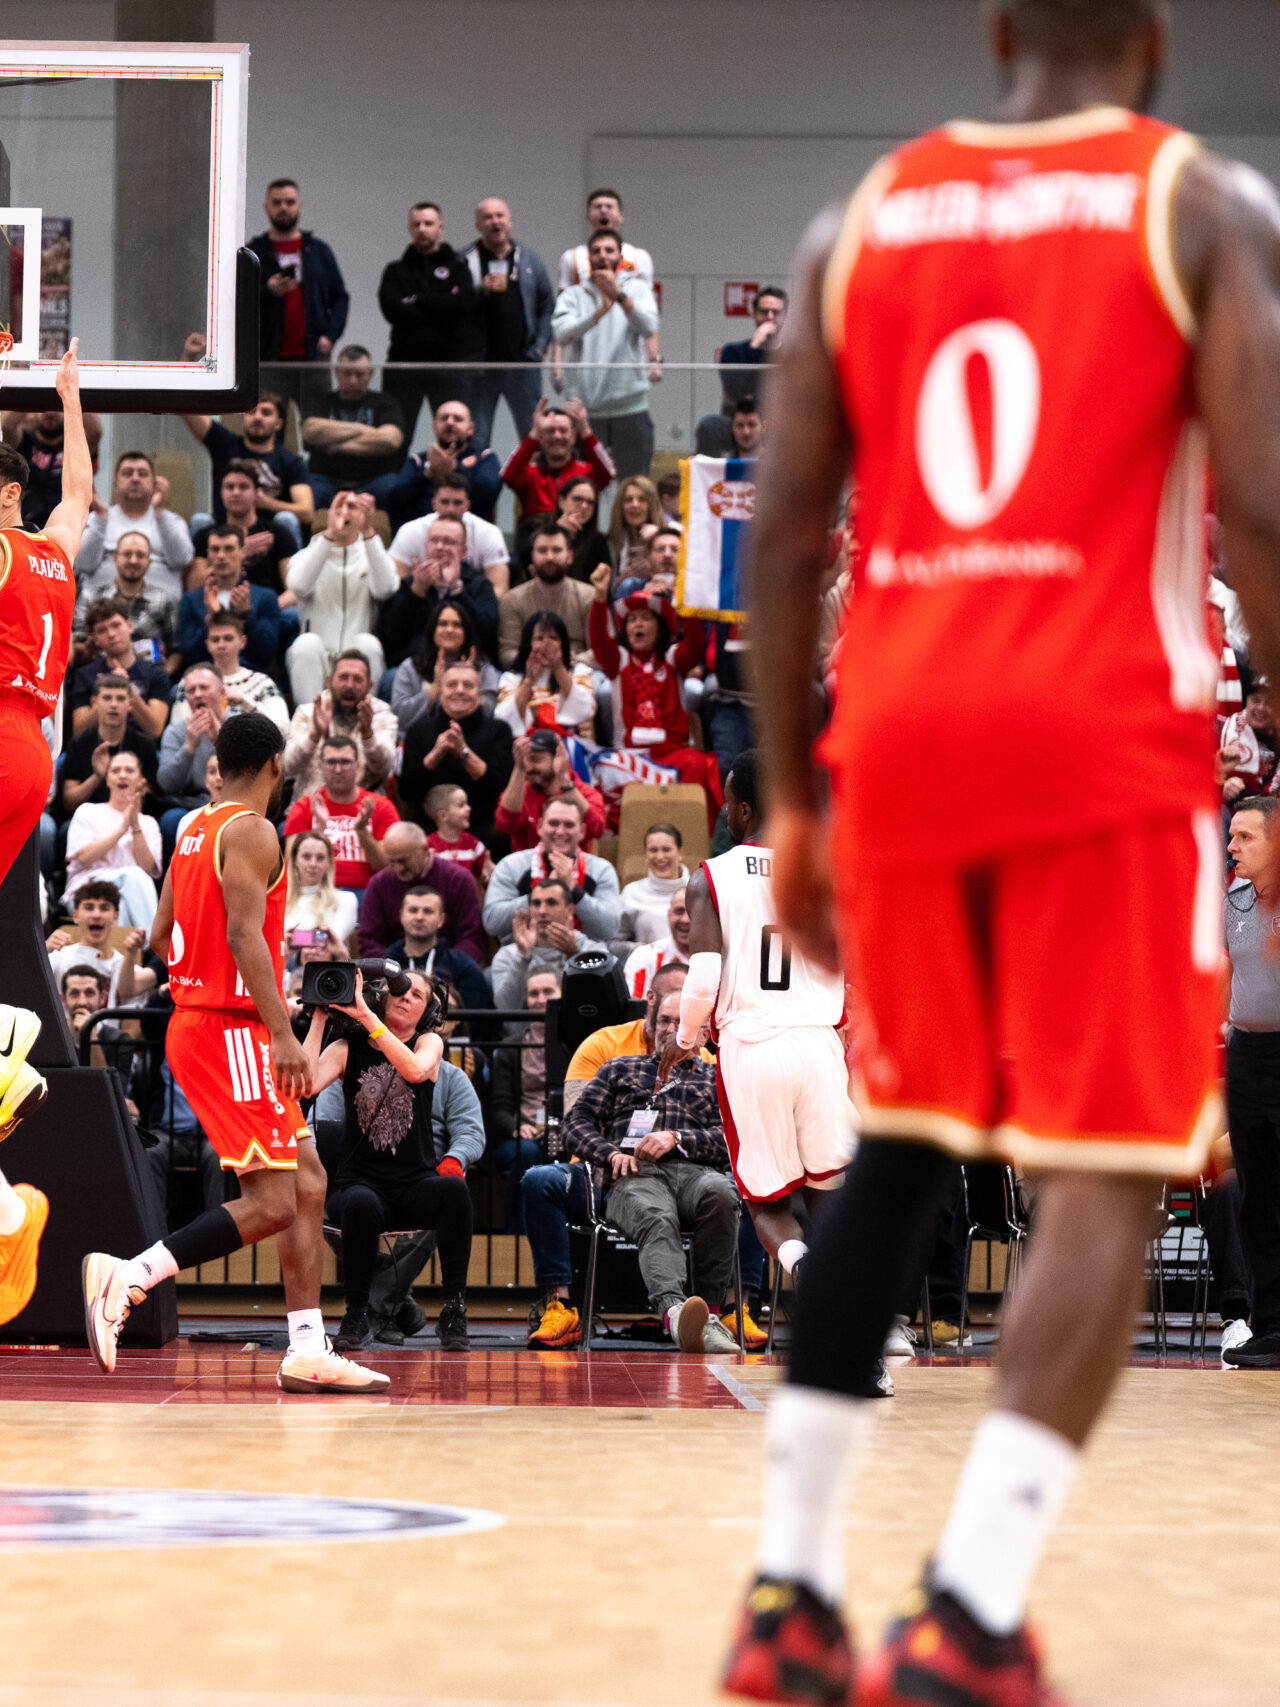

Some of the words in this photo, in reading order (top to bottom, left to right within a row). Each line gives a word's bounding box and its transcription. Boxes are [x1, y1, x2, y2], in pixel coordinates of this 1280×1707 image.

[914, 316, 1041, 530] 0
[27, 554, 68, 582] PLAVŠIĆ
[35, 612, 53, 681] 1
[760, 924, 793, 991] 0
